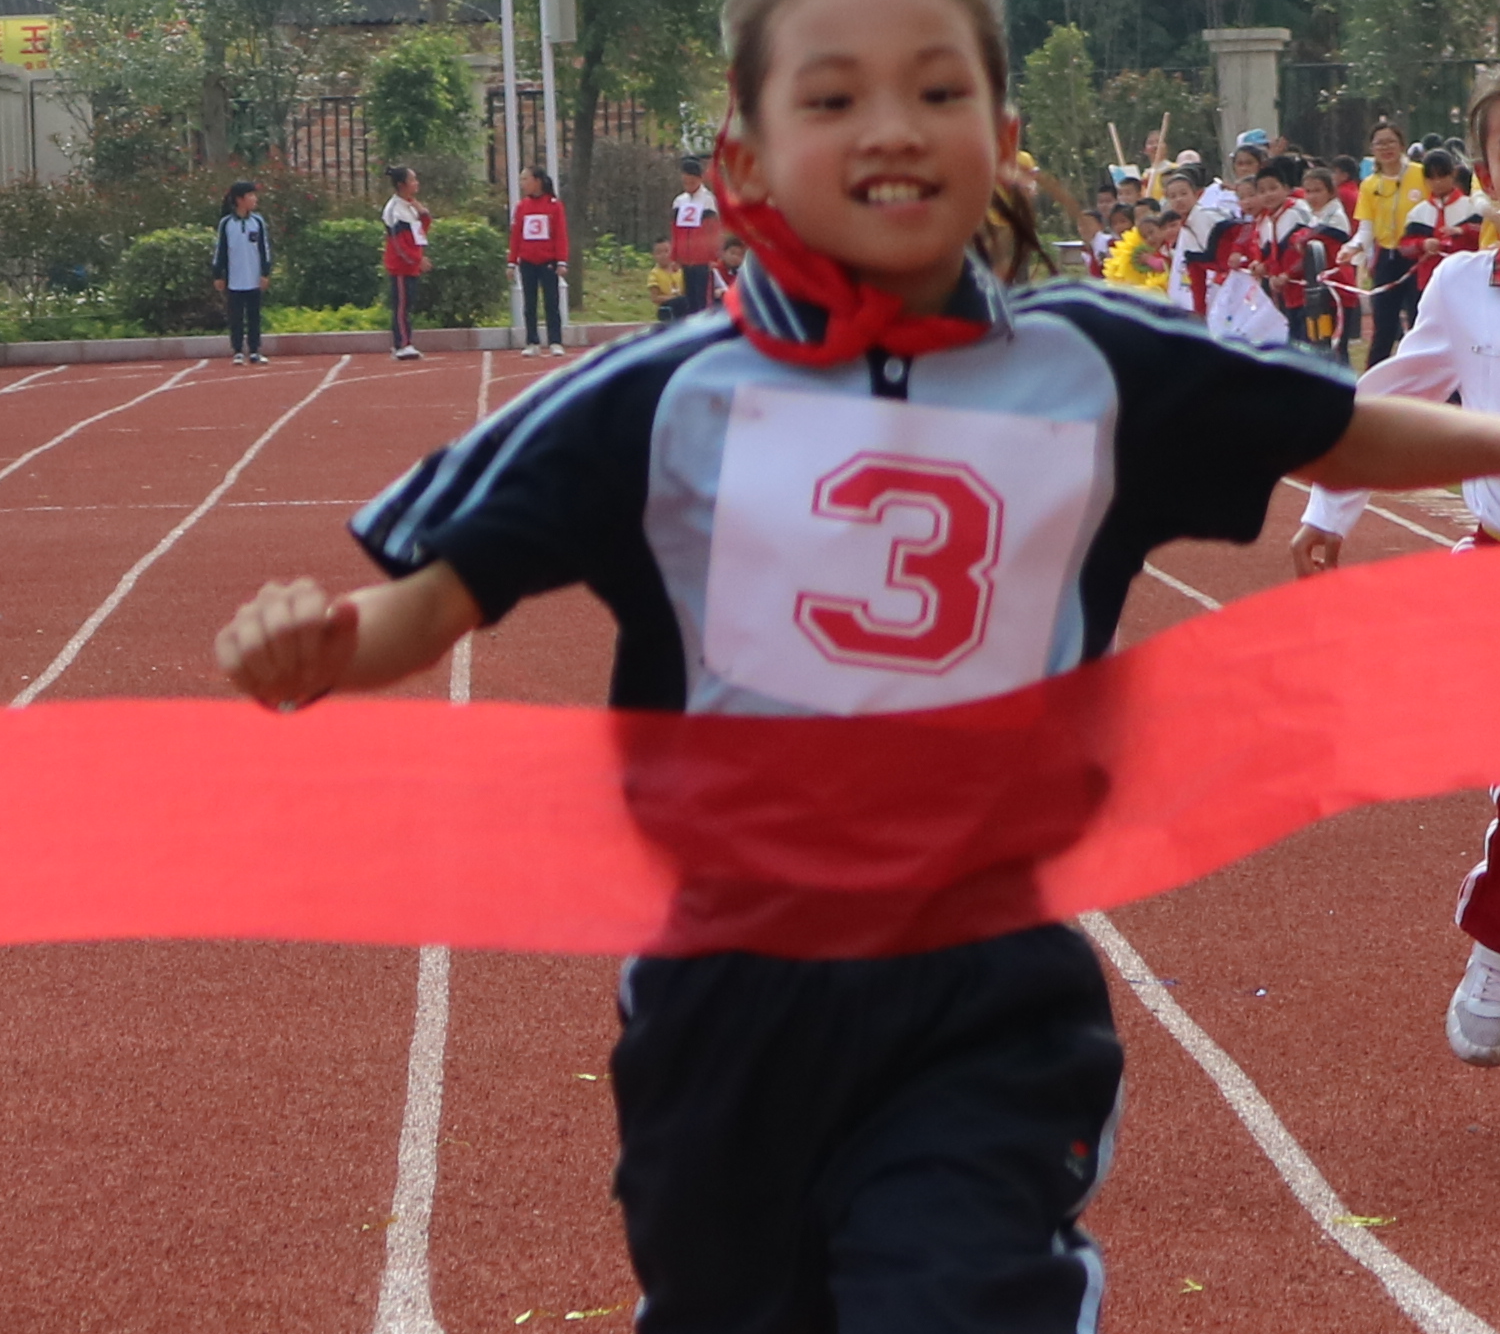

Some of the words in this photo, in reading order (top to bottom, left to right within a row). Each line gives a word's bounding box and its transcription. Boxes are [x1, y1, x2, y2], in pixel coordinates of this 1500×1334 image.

[683, 207, 696, 222] 2
[528, 220, 543, 235] 3
[794, 451, 1003, 676] 3
